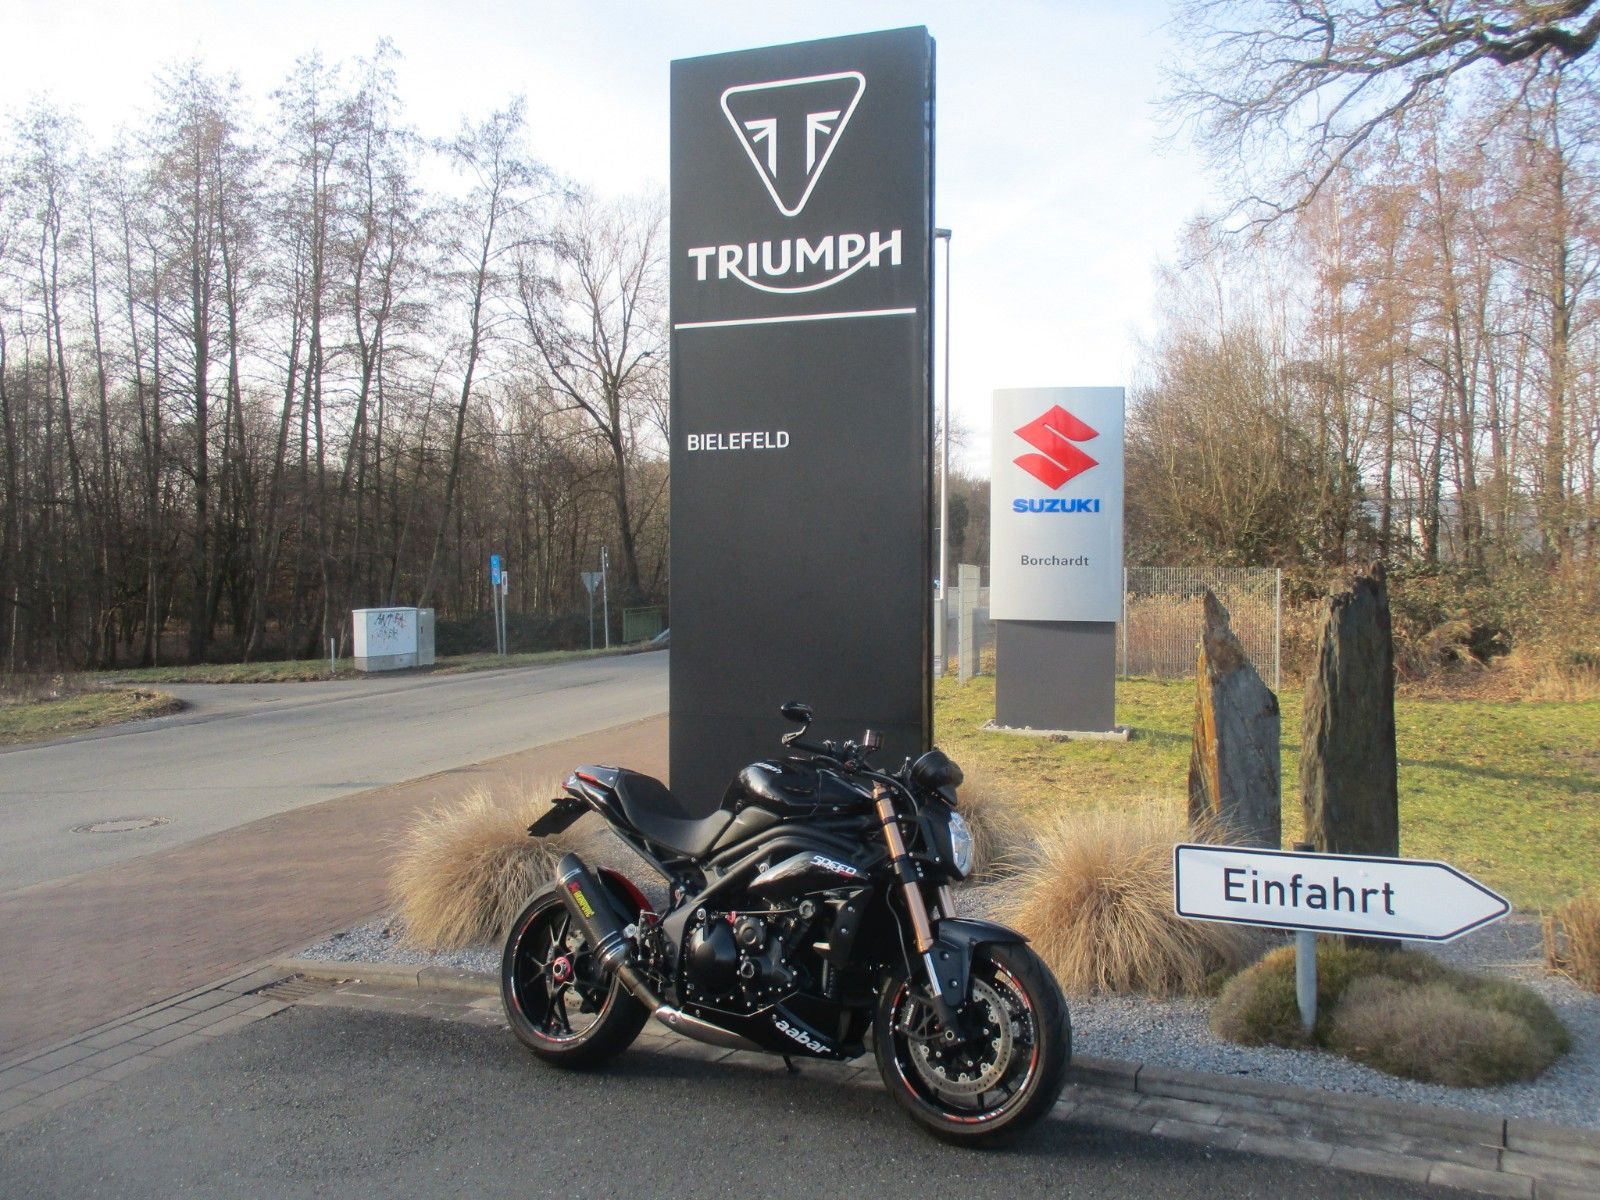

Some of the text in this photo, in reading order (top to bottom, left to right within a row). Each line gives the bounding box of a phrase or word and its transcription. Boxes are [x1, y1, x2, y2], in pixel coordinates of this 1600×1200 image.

[688, 230, 902, 293] TRIUMPH
[687, 431, 790, 452] BIELEFELD
[1012, 498, 1100, 513] SUZUKI
[1021, 555, 1089, 567] Borchardt
[810, 855, 857, 875] SPEED
[1224, 867, 1396, 916] Einfahrt
[775, 1020, 832, 1053] aabar
